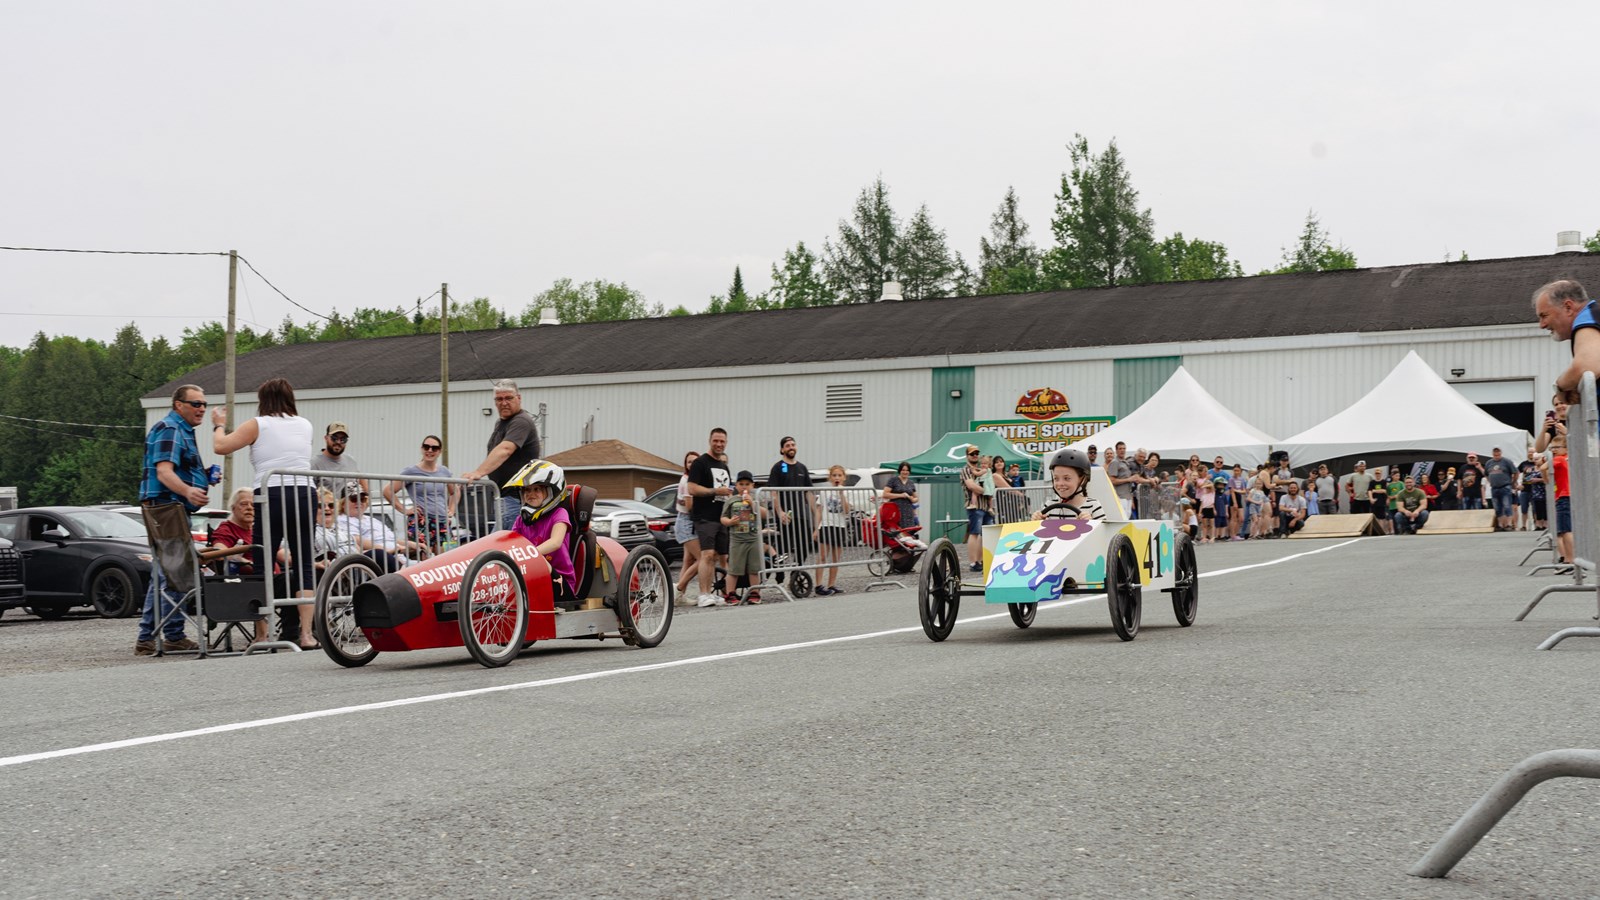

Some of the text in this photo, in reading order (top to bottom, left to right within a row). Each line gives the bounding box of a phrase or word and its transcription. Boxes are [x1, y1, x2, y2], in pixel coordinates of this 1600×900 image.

[1009, 539, 1055, 554] 41
[1143, 531, 1163, 578] 41
[481, 574, 497, 585] Rue
